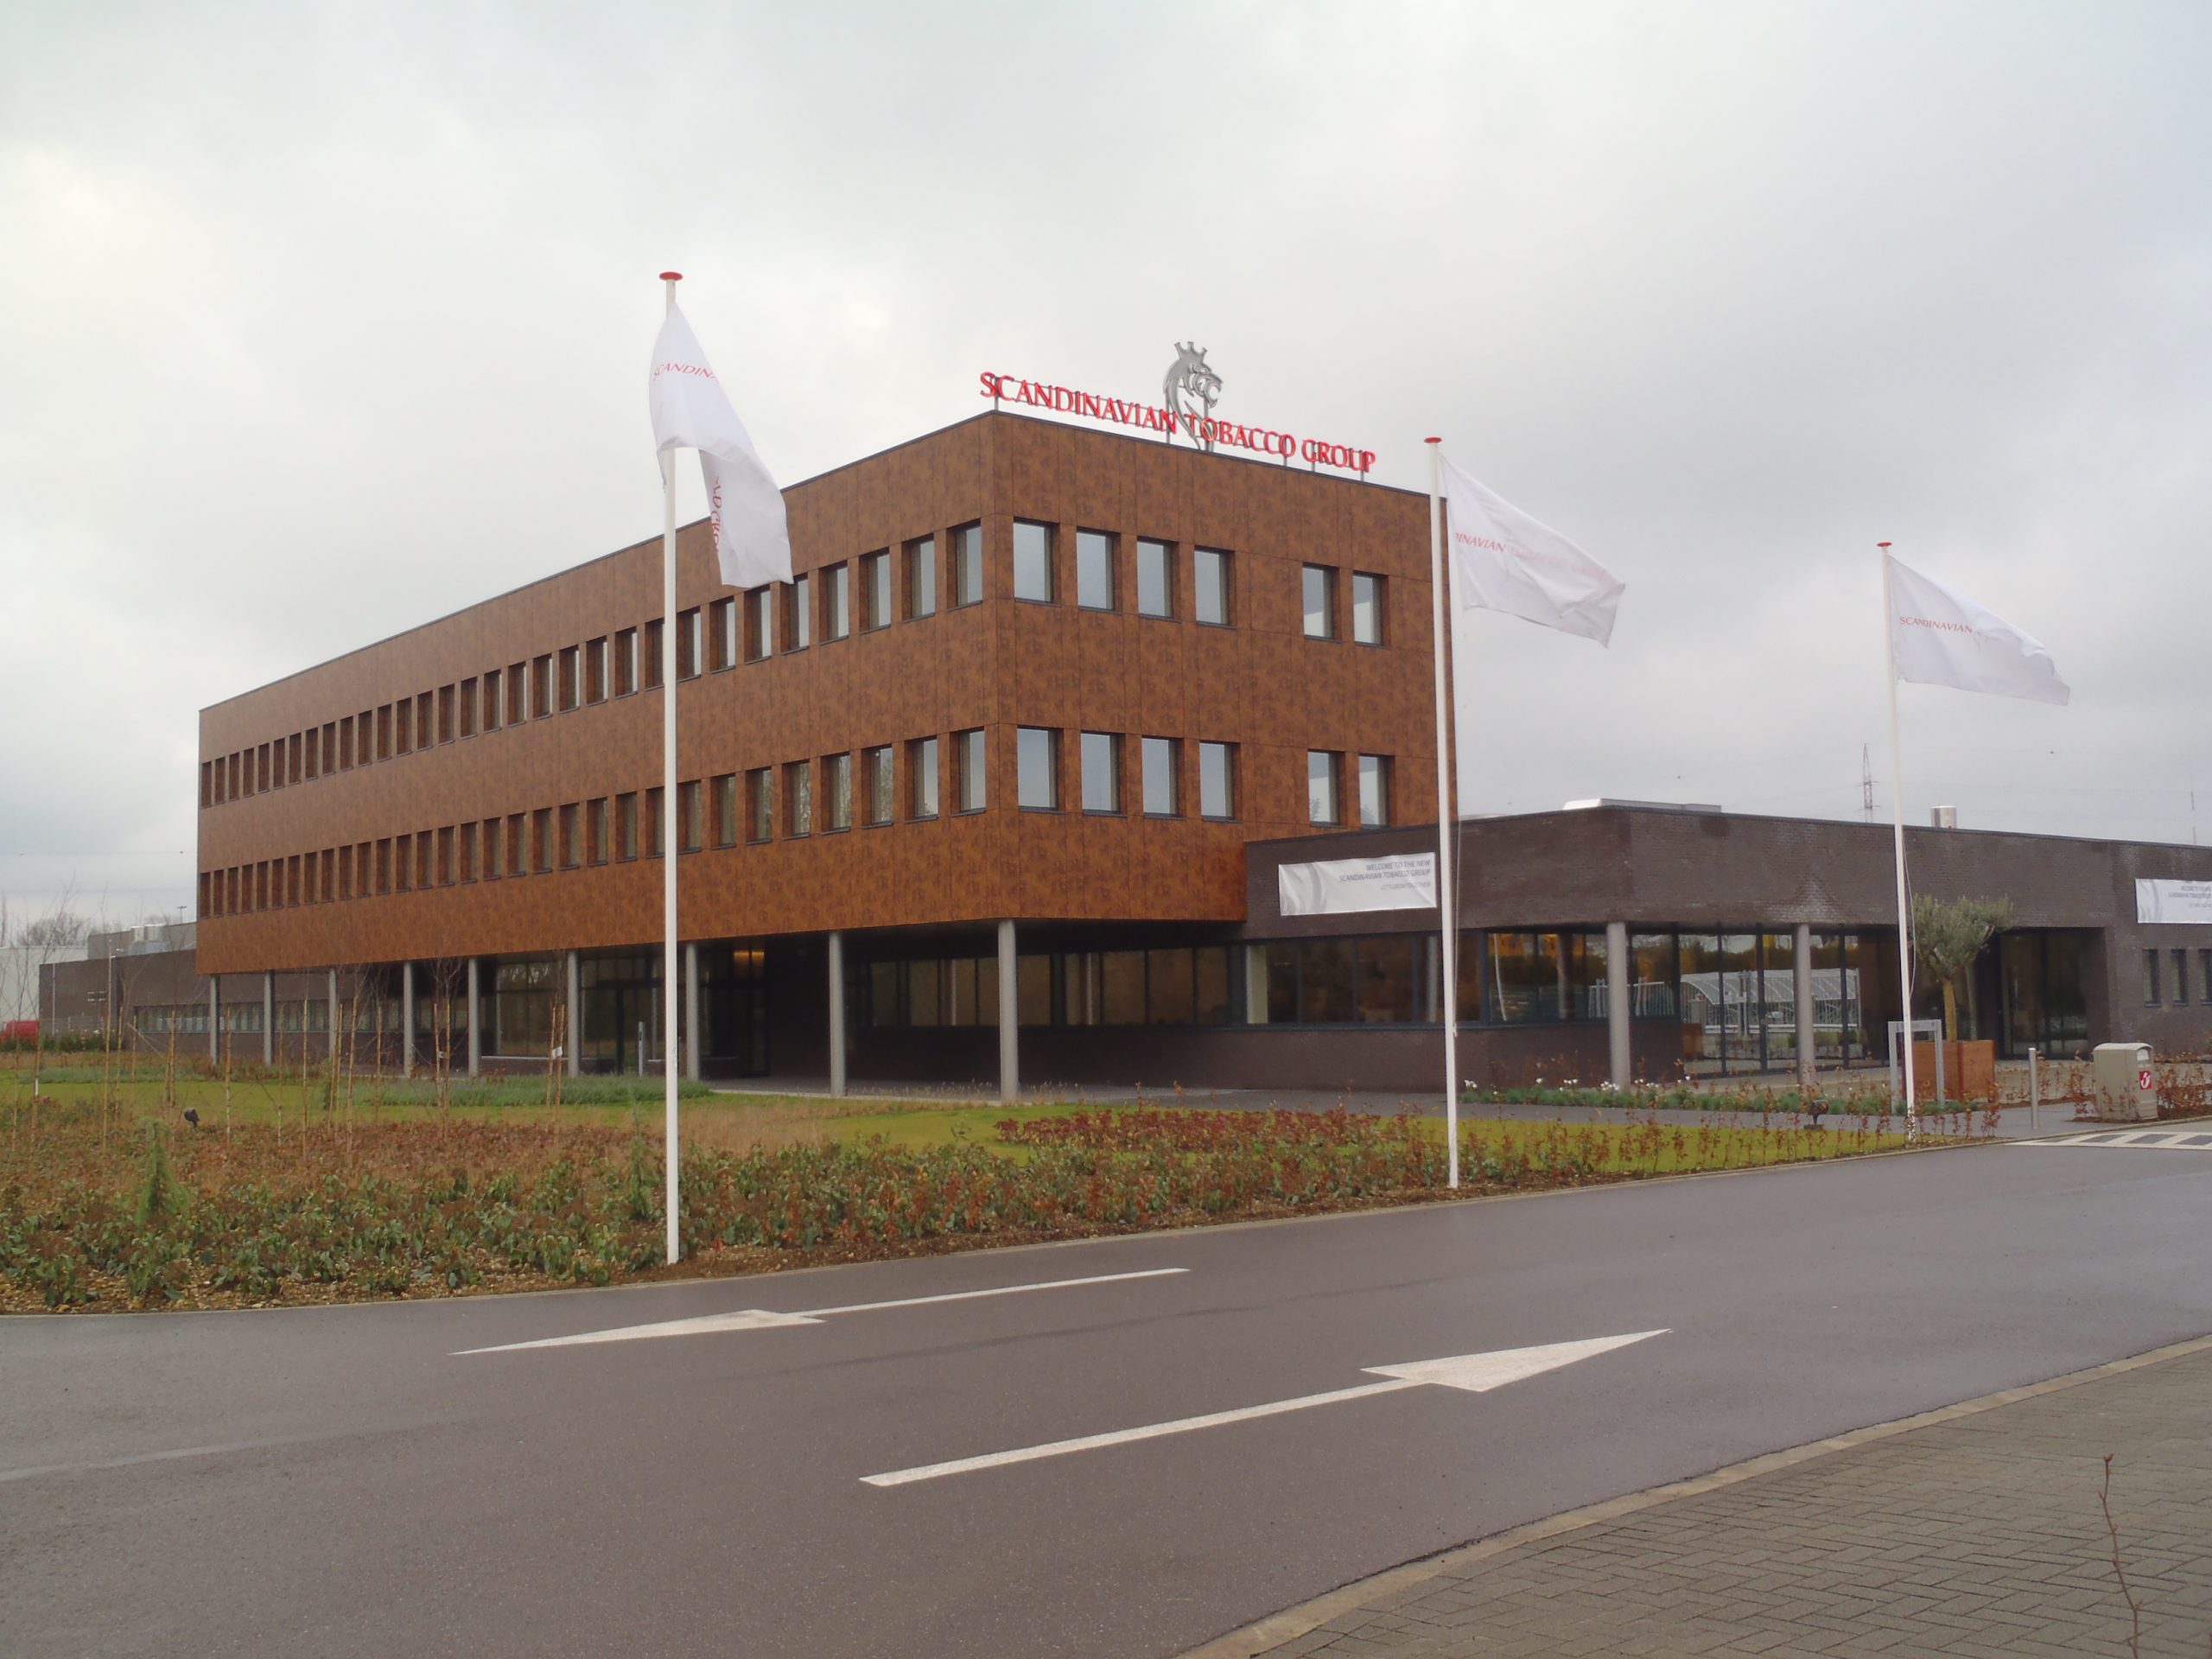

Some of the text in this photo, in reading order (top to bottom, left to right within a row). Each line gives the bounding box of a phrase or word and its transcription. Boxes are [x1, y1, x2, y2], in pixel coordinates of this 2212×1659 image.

[980, 372, 1376, 473] SCANDINAVIAN TOBACCO GROUP
[1899, 616, 1974, 633] SCANDINAVIAN
